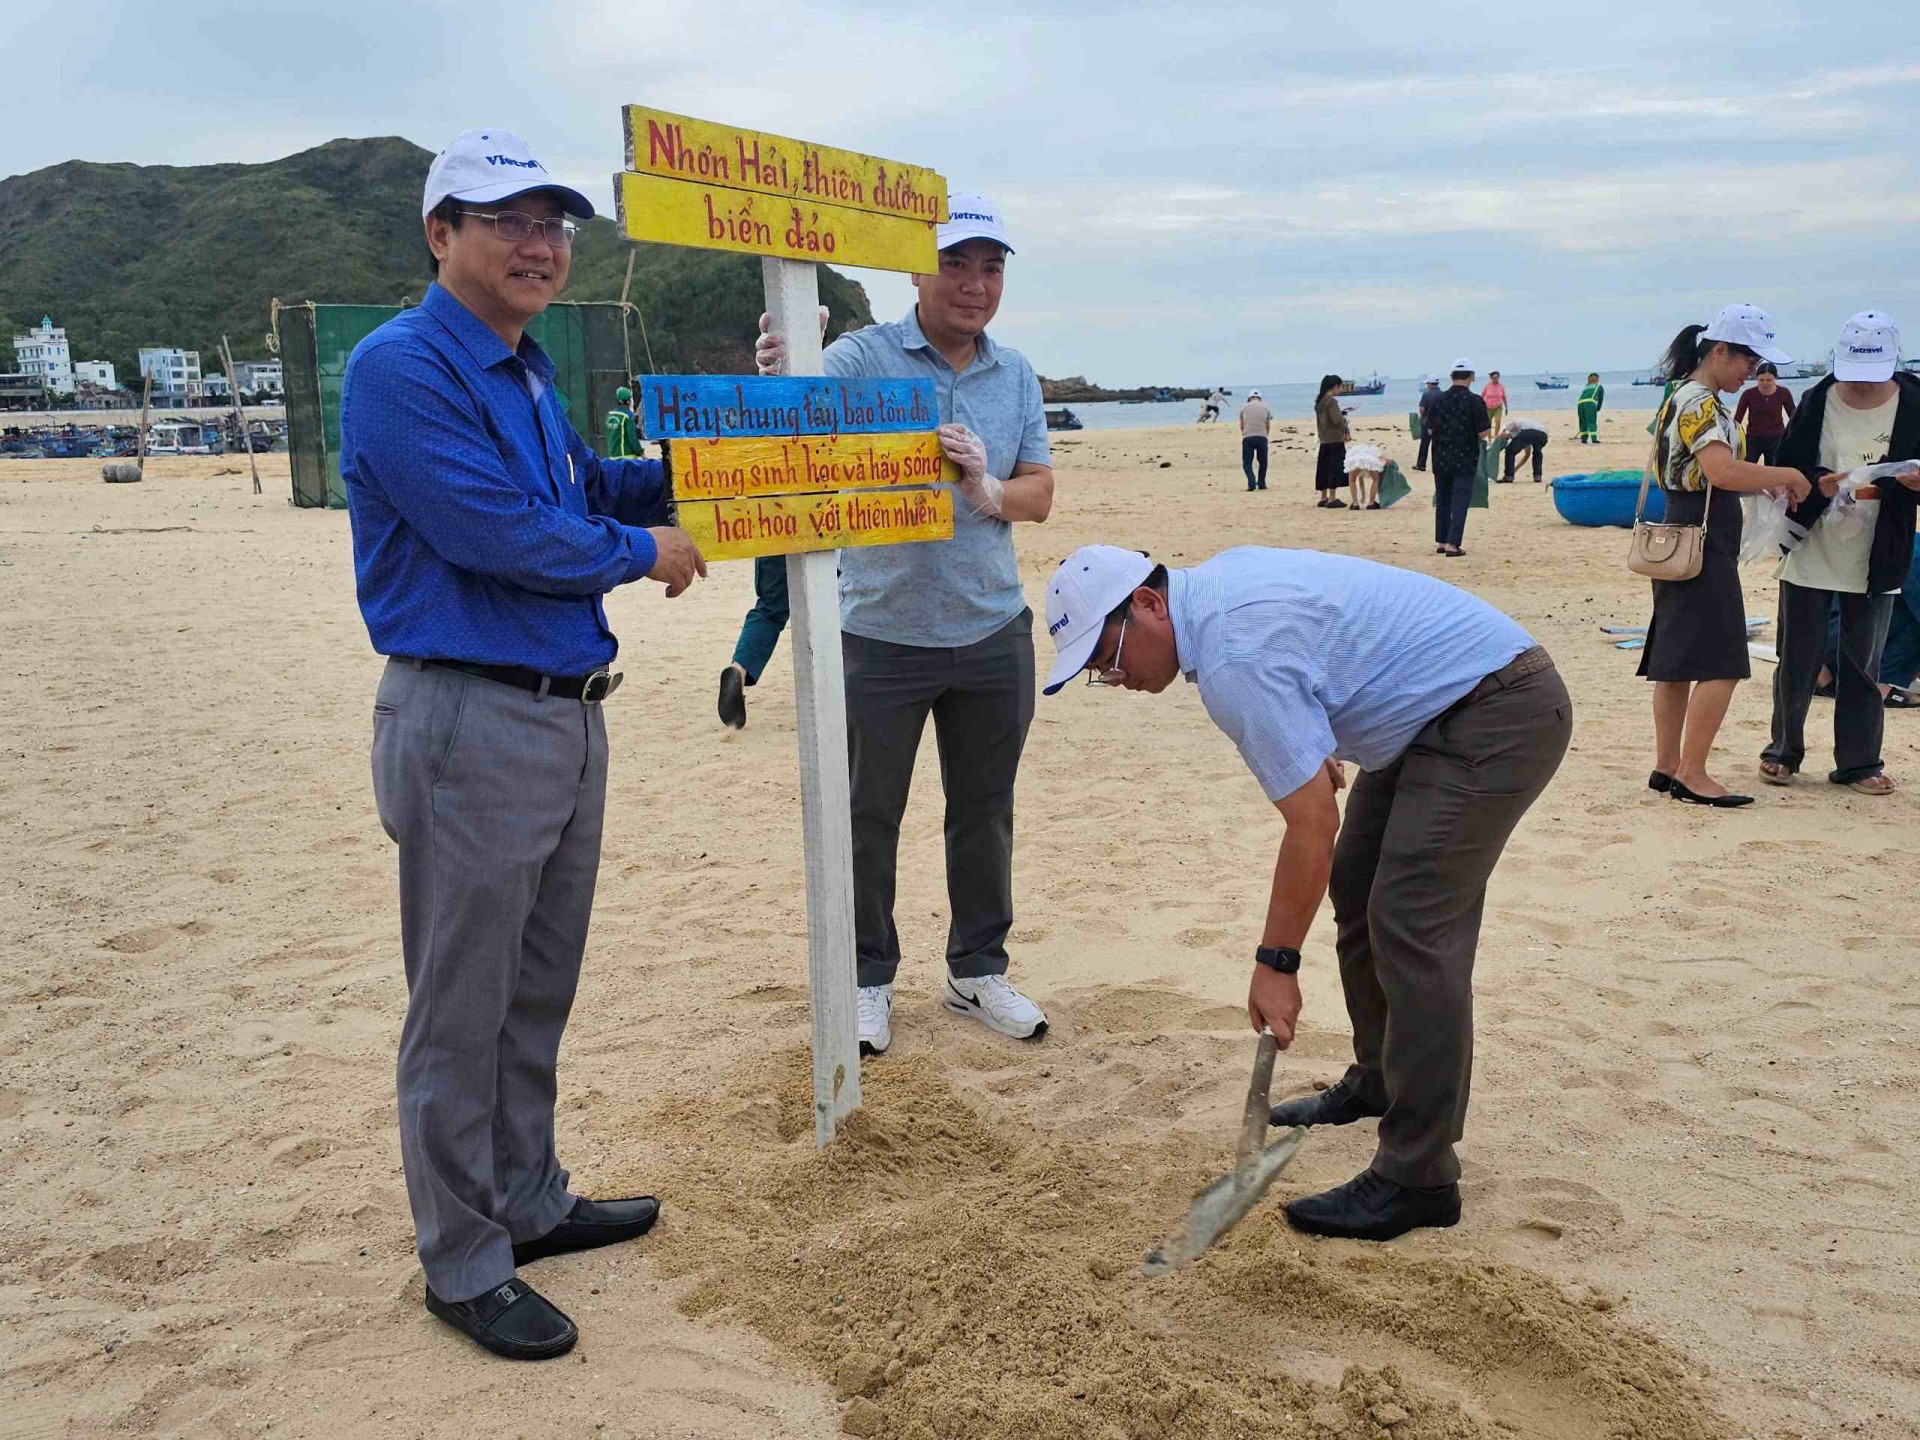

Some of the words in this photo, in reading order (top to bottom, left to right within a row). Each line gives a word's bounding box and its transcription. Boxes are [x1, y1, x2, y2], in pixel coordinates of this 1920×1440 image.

[649, 119, 729, 180] Nhơn
[804, 151, 865, 204] thiên
[872, 166, 940, 230] đường
[704, 193, 771, 246] biển
[786, 207, 835, 253] đảo
[654, 384, 720, 446] Hãy
[725, 384, 800, 445] chung
[841, 386, 874, 426] bảo
[877, 390, 906, 423] tồn
[750, 445, 797, 486] sinh
[801, 443, 841, 489] học
[843, 455, 866, 481] và
[868, 447, 900, 485] hãy
[903, 441, 942, 499] sống
[715, 503, 753, 543] hài
[757, 502, 798, 538] hòa
[808, 497, 841, 534] với
[846, 497, 891, 531] thiên
